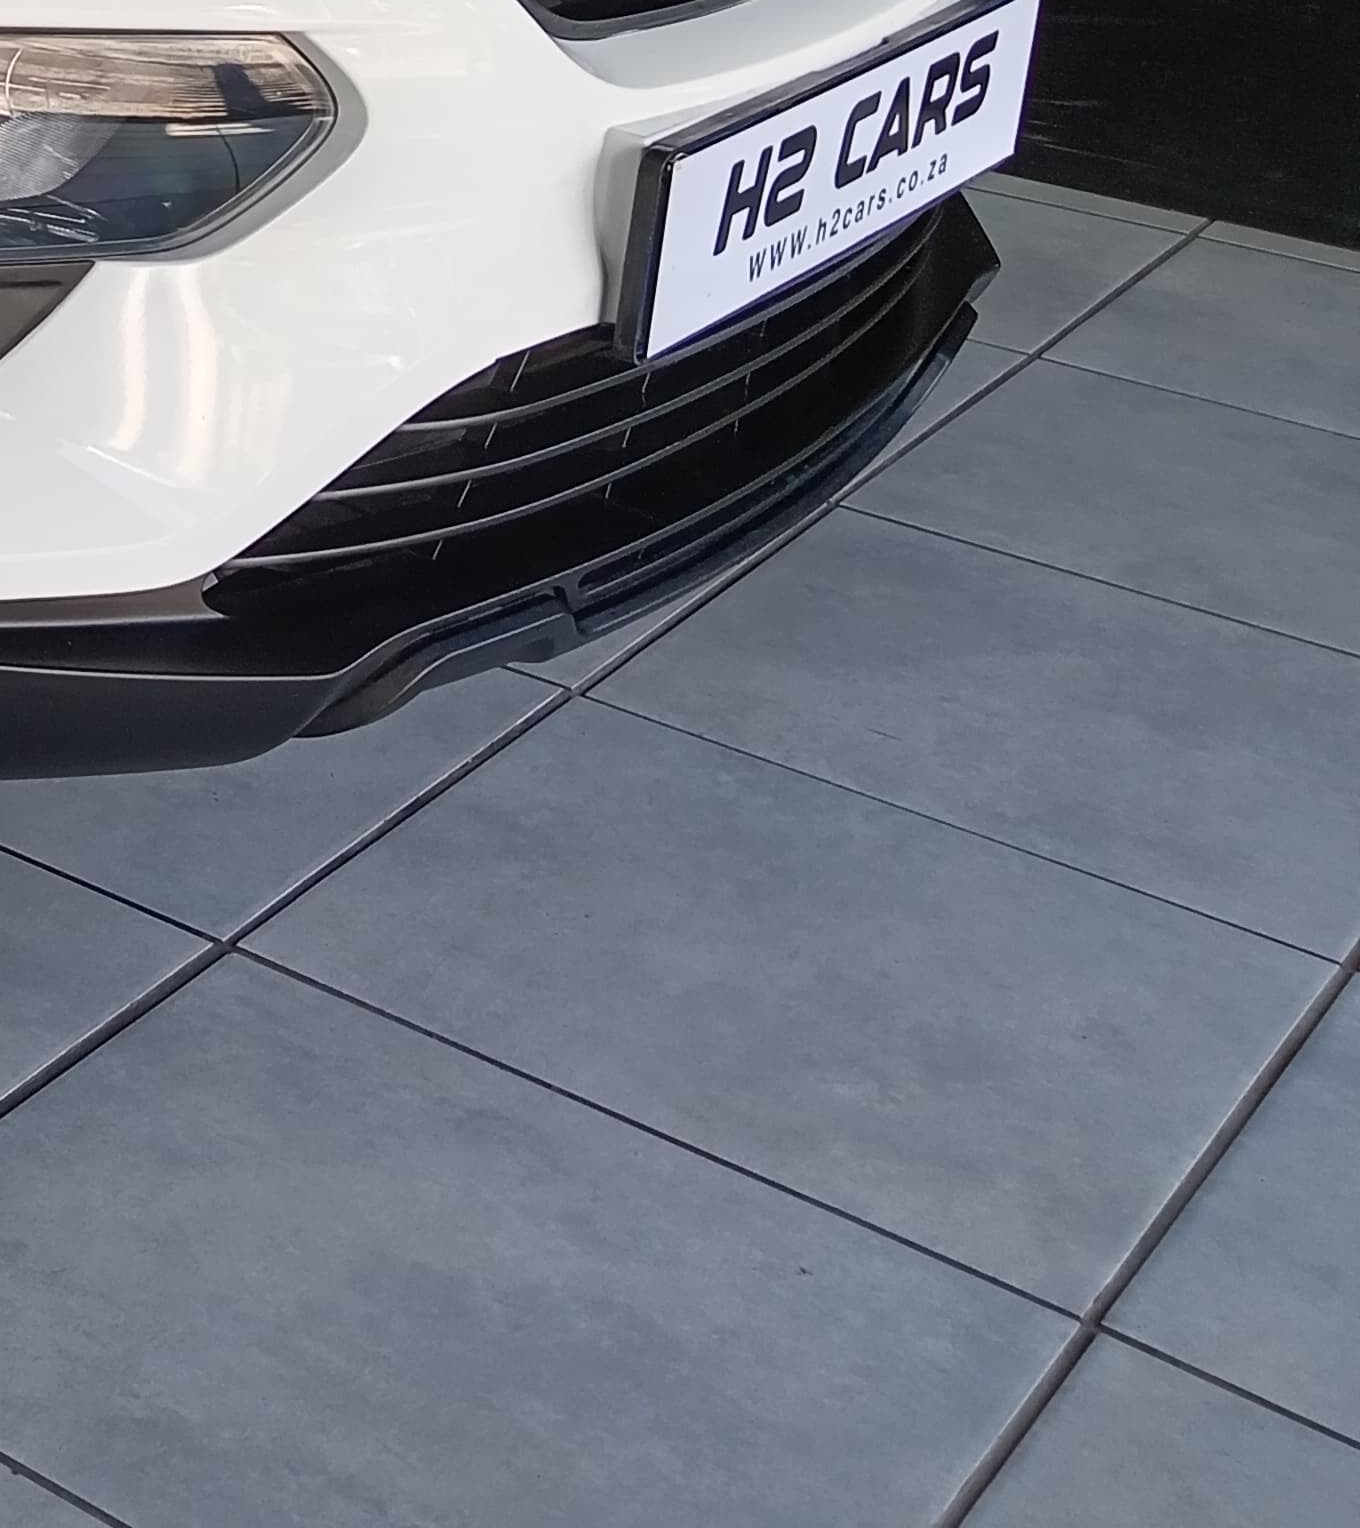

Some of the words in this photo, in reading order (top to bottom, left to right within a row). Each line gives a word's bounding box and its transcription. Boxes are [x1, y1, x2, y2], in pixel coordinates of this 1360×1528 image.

[712, 124, 818, 256] H2
[834, 29, 999, 189] CARS
[747, 152, 948, 282] www.h2cars.co.za
